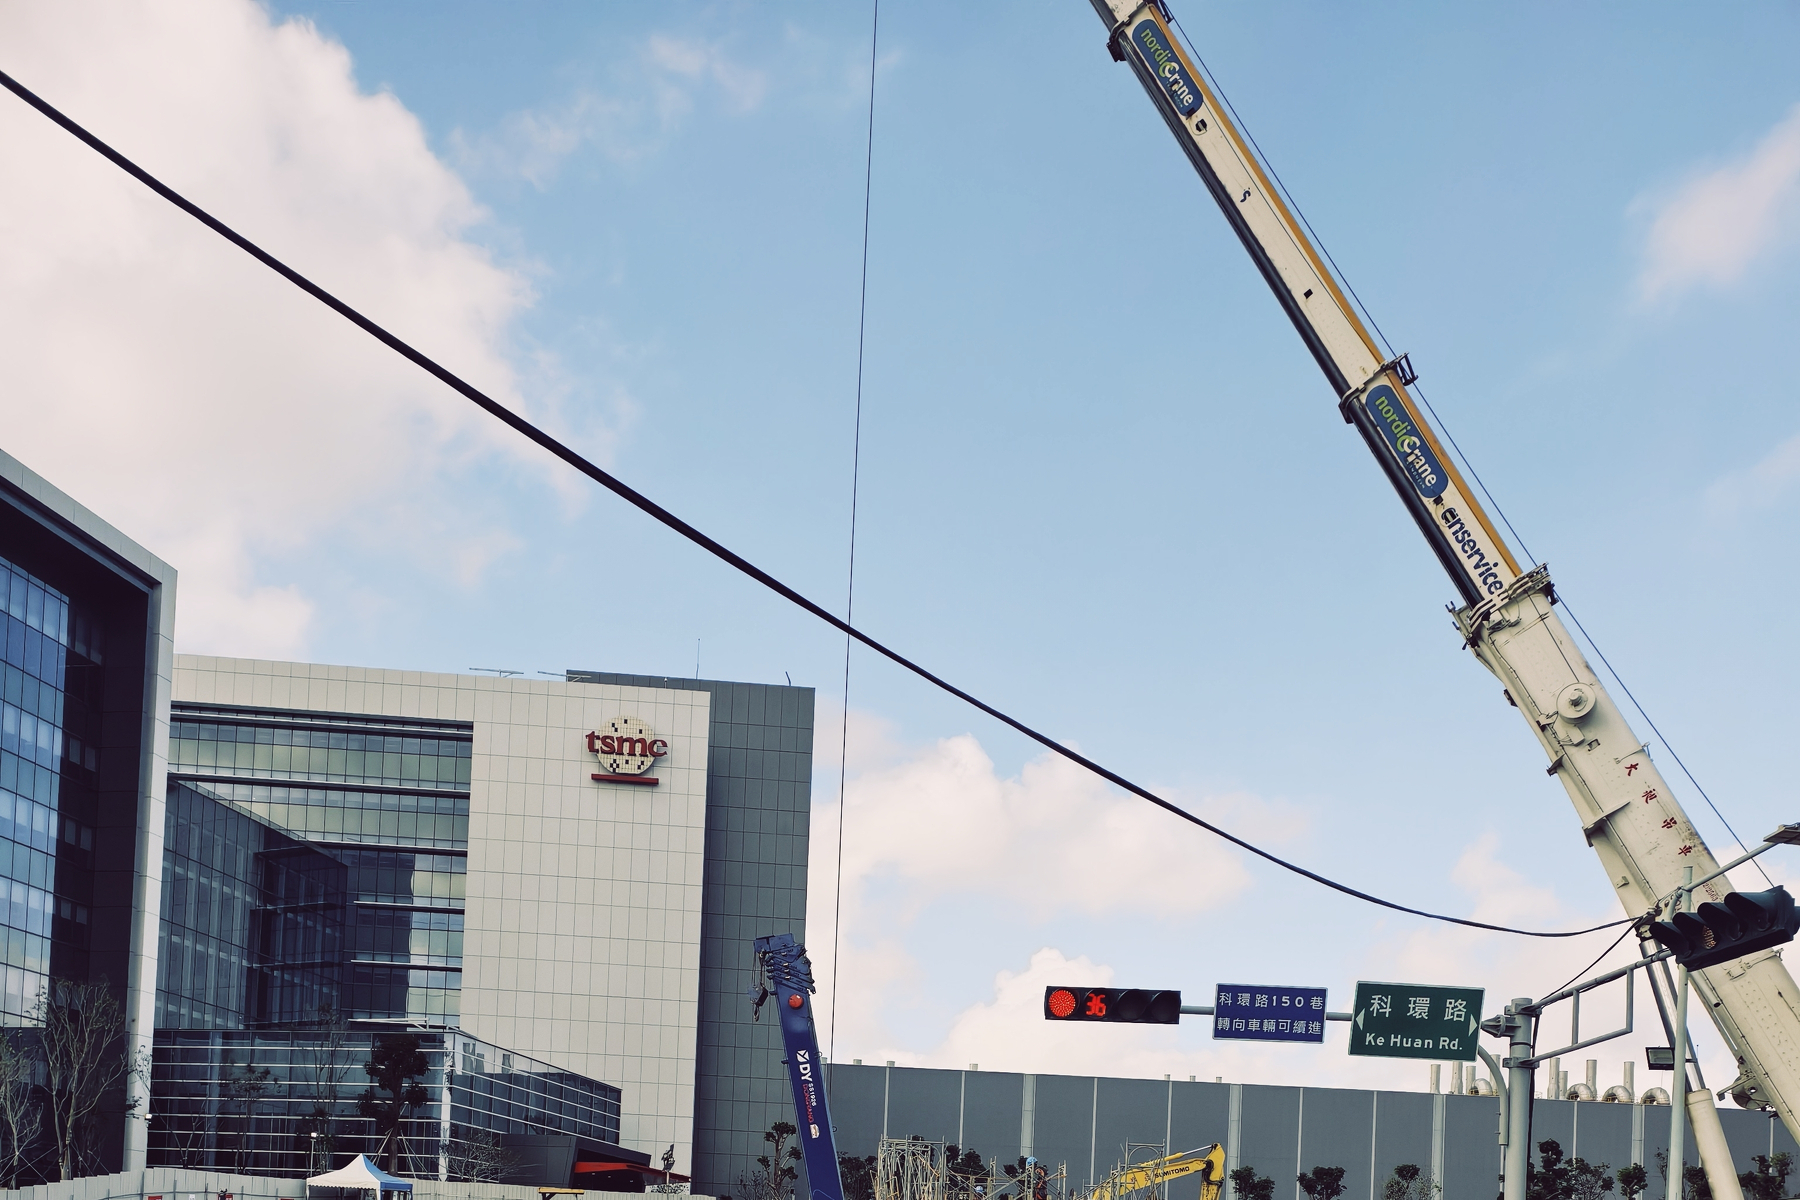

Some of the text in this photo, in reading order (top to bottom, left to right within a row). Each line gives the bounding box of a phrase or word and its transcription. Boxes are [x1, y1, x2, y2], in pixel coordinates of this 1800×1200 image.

[585, 731, 668, 757] tsmc
[1086, 993, 1106, 1017] 36
[1370, 994, 1467, 1022] 科環路
[1217, 1017, 1322, 1035] 轉向車輛可續進
[1365, 1033, 1463, 1050] Ke Huan Rd.
[799, 1063, 813, 1082] DY
